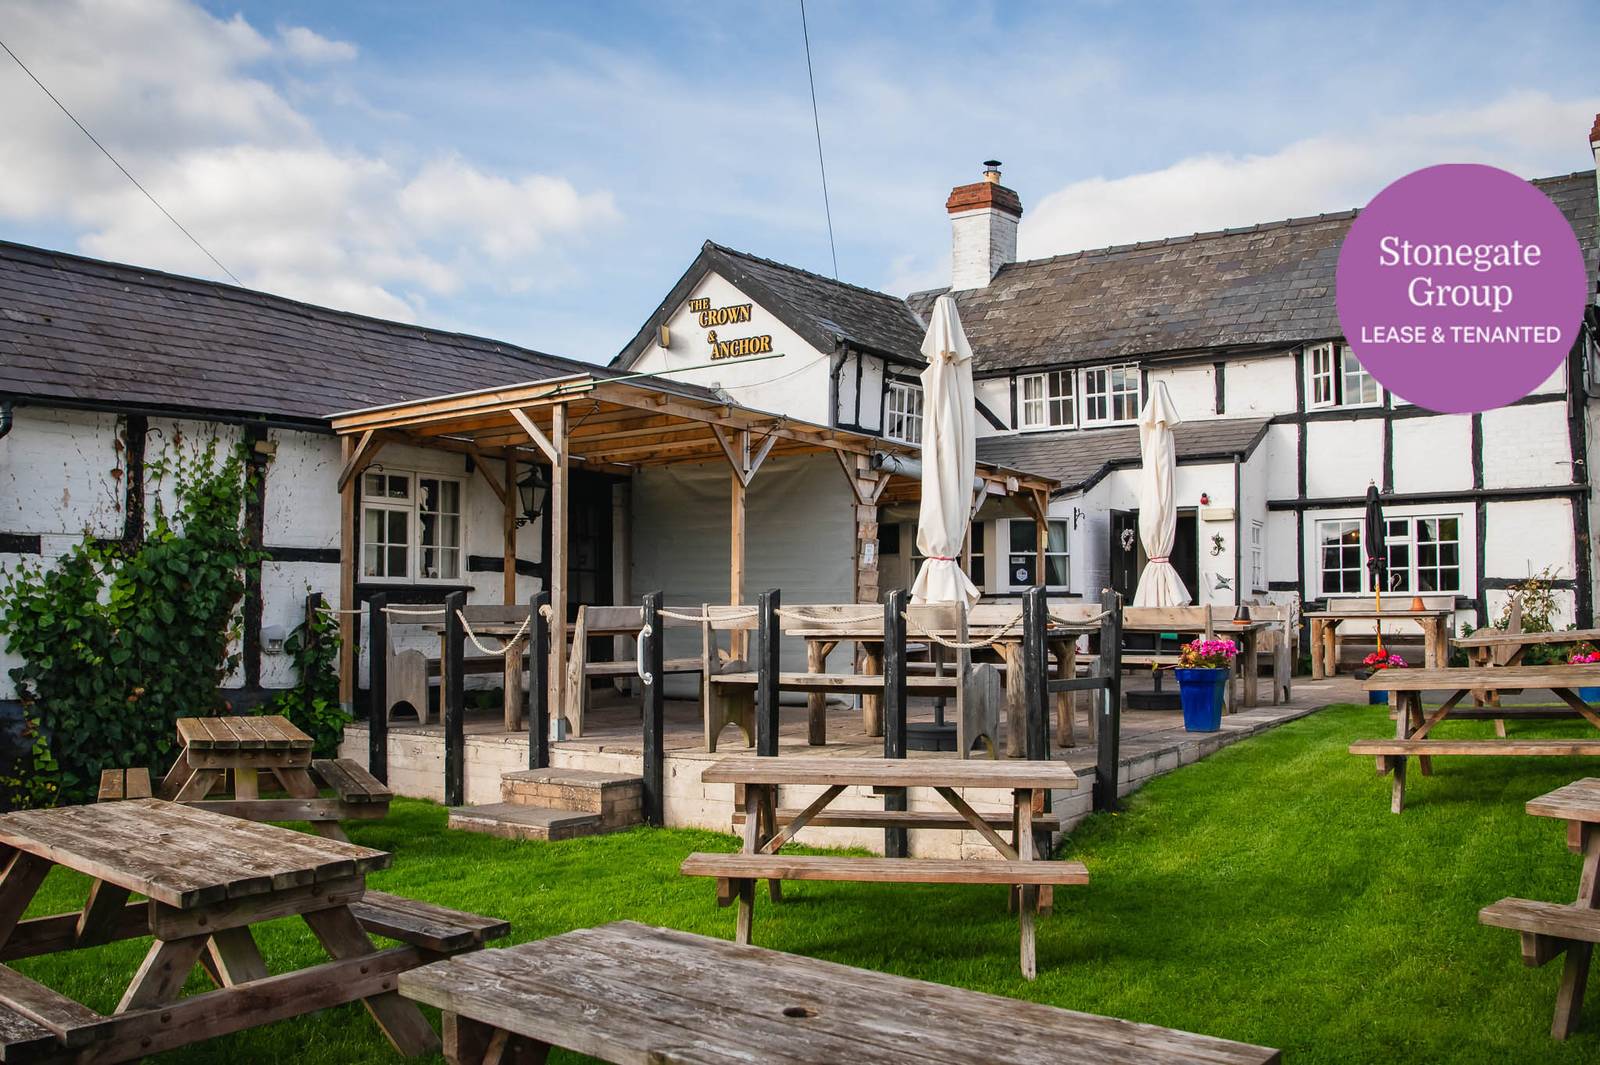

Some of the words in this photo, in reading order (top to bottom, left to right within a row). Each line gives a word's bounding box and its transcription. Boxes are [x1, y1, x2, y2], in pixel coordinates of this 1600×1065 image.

[689, 298, 710, 313] THE
[699, 304, 752, 328] CROWN
[707, 330, 718, 344] &
[711, 335, 773, 360] ANCHOR
